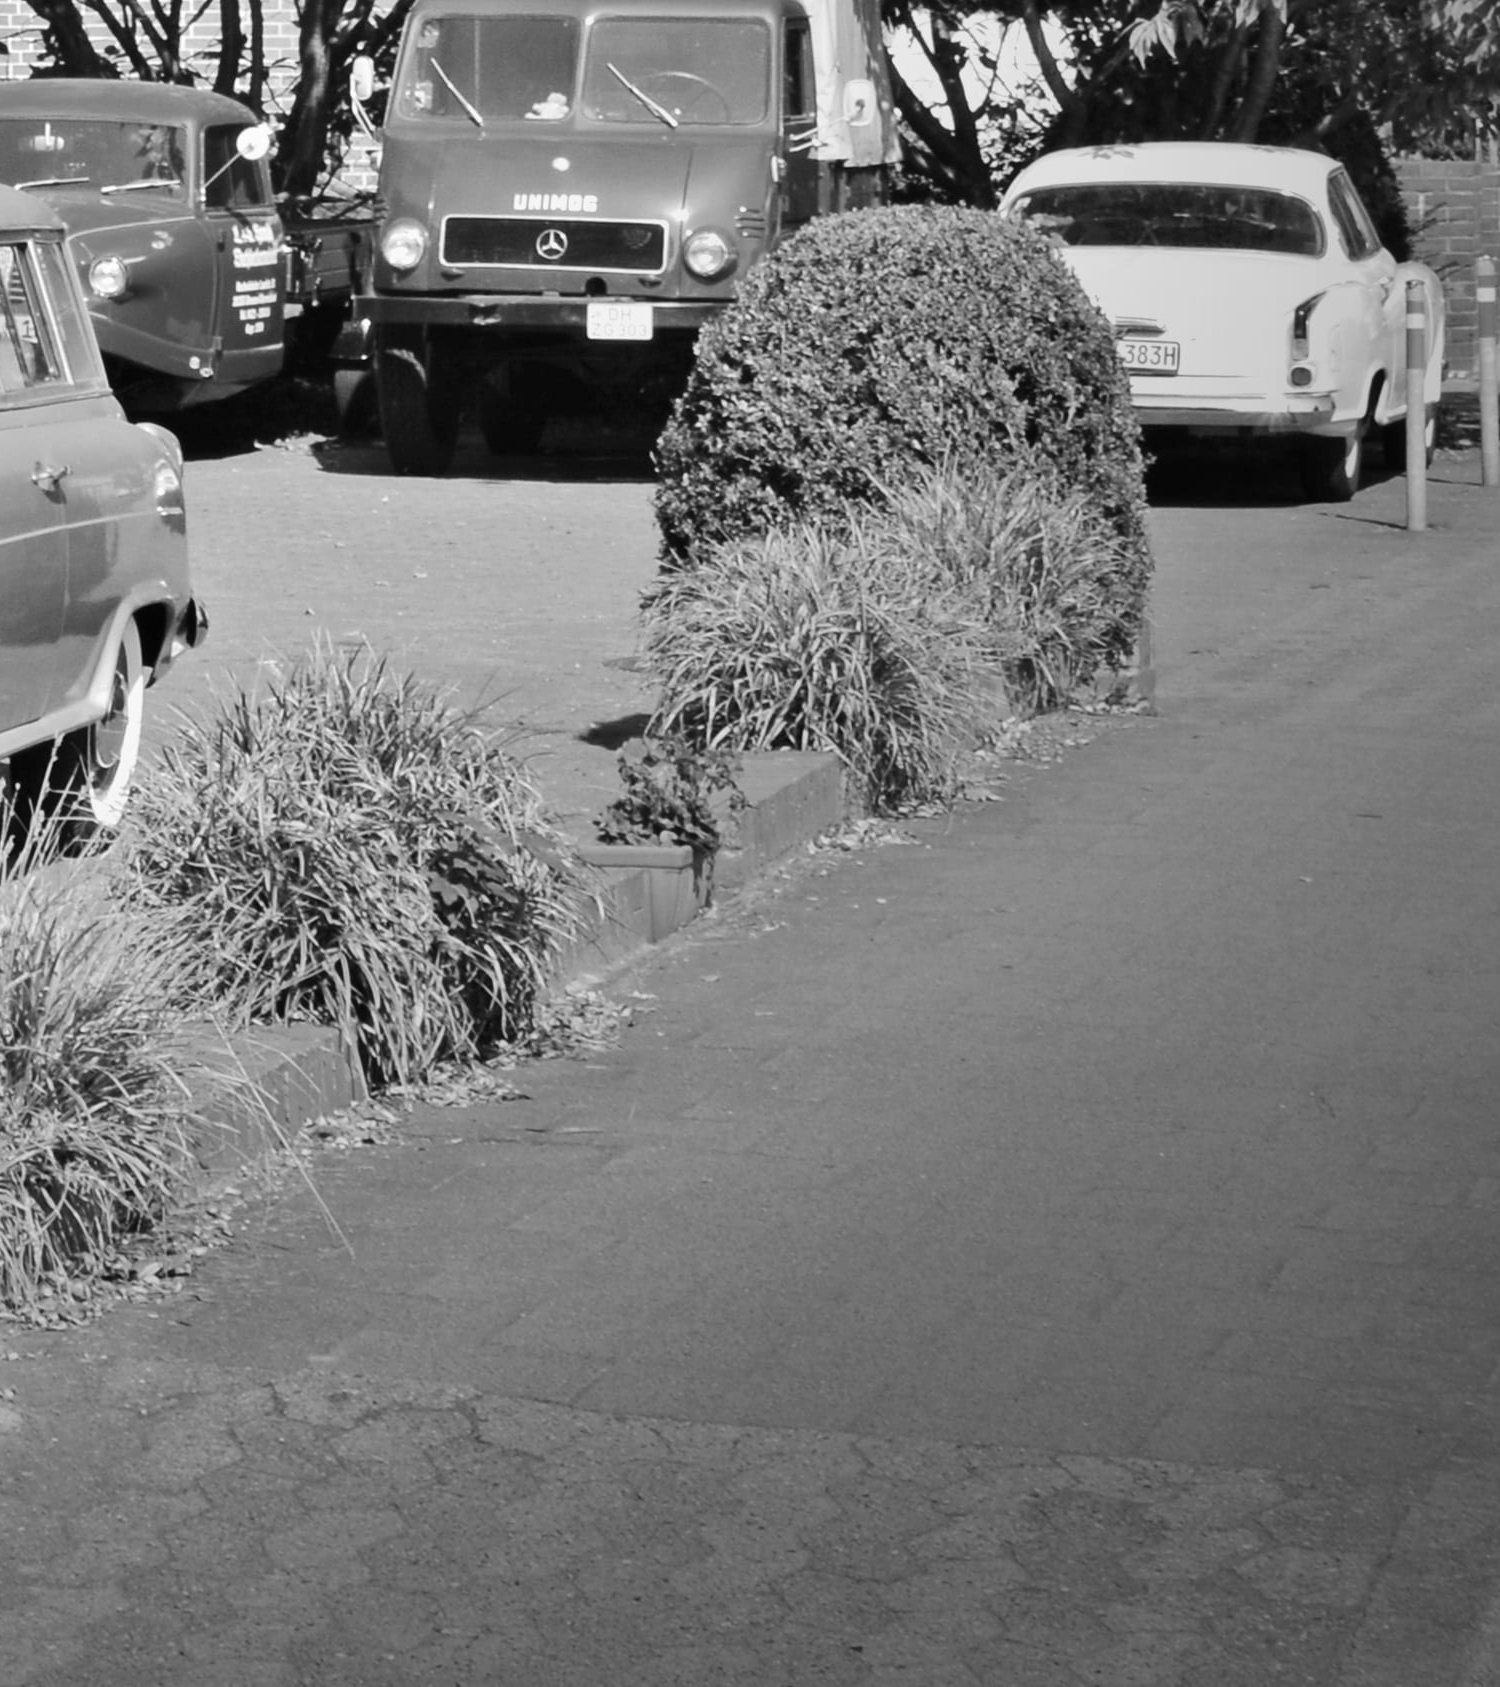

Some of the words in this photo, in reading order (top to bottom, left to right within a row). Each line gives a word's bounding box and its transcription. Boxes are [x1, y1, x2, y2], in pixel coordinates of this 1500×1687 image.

[513, 193, 599, 213] UNIMOG
[608, 307, 632, 321] DH
[1123, 344, 1177, 366] 383H
